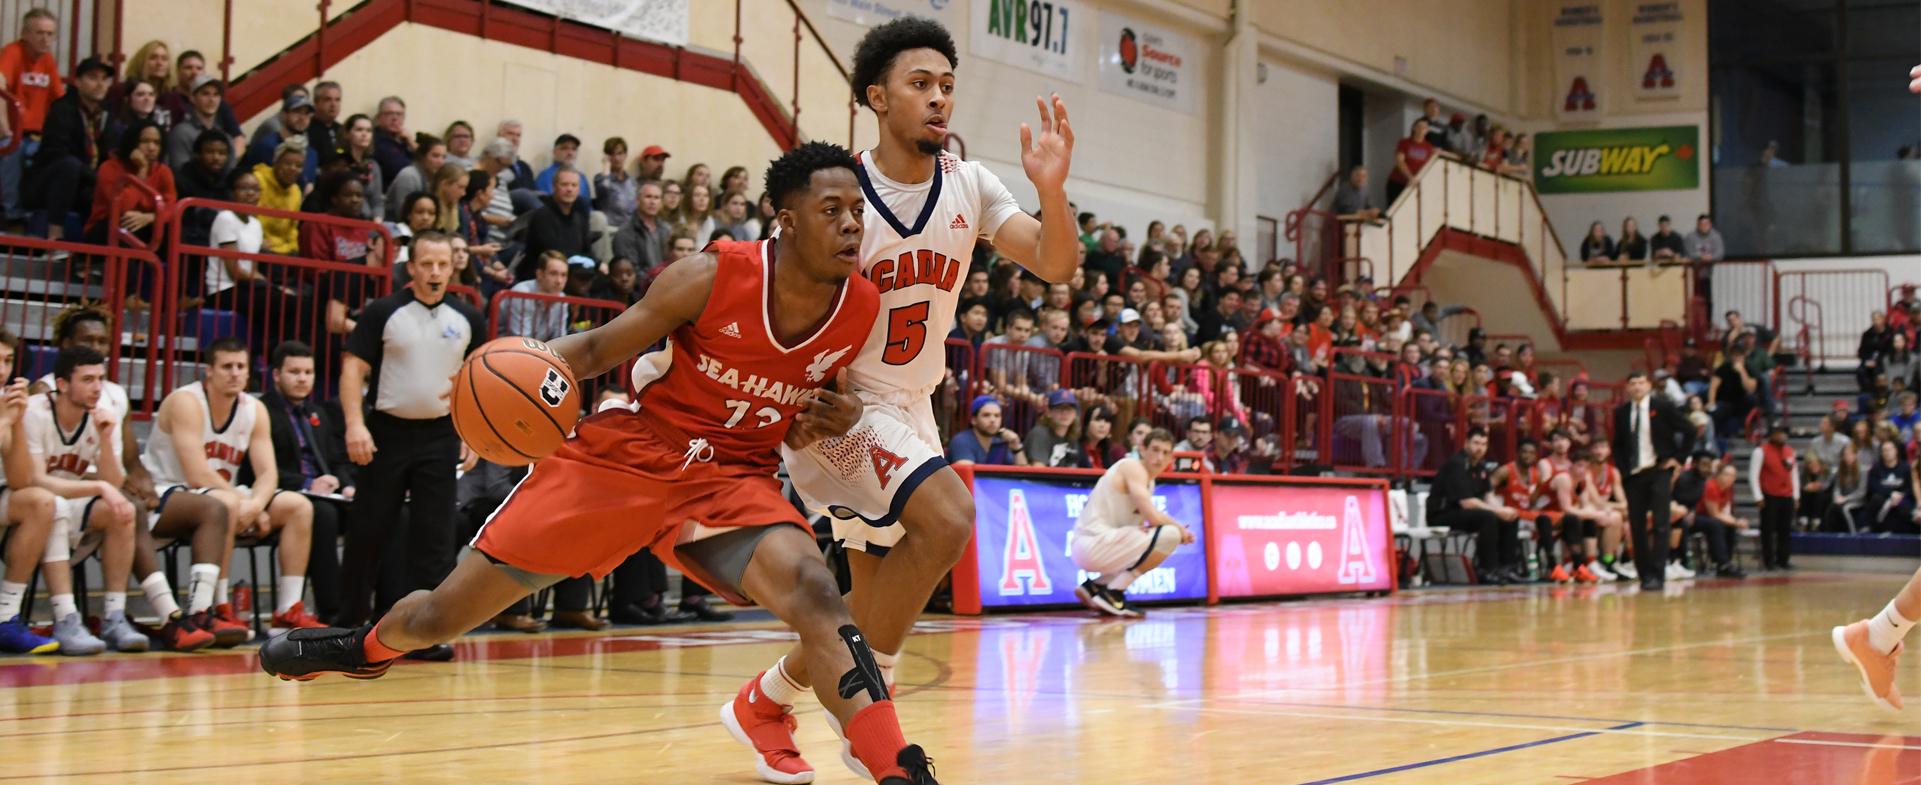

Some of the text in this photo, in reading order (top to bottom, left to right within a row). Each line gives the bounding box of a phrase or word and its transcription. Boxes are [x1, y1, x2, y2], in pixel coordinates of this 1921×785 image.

[1141, 44, 1182, 67] Source
[1542, 144, 1671, 177] SUBWAY
[861, 249, 960, 294] CADIA
[881, 300, 930, 366] 5
[869, 445, 909, 490] A
[999, 488, 1053, 596] A
[1337, 495, 1377, 584] A
[851, 634, 862, 643] KT
